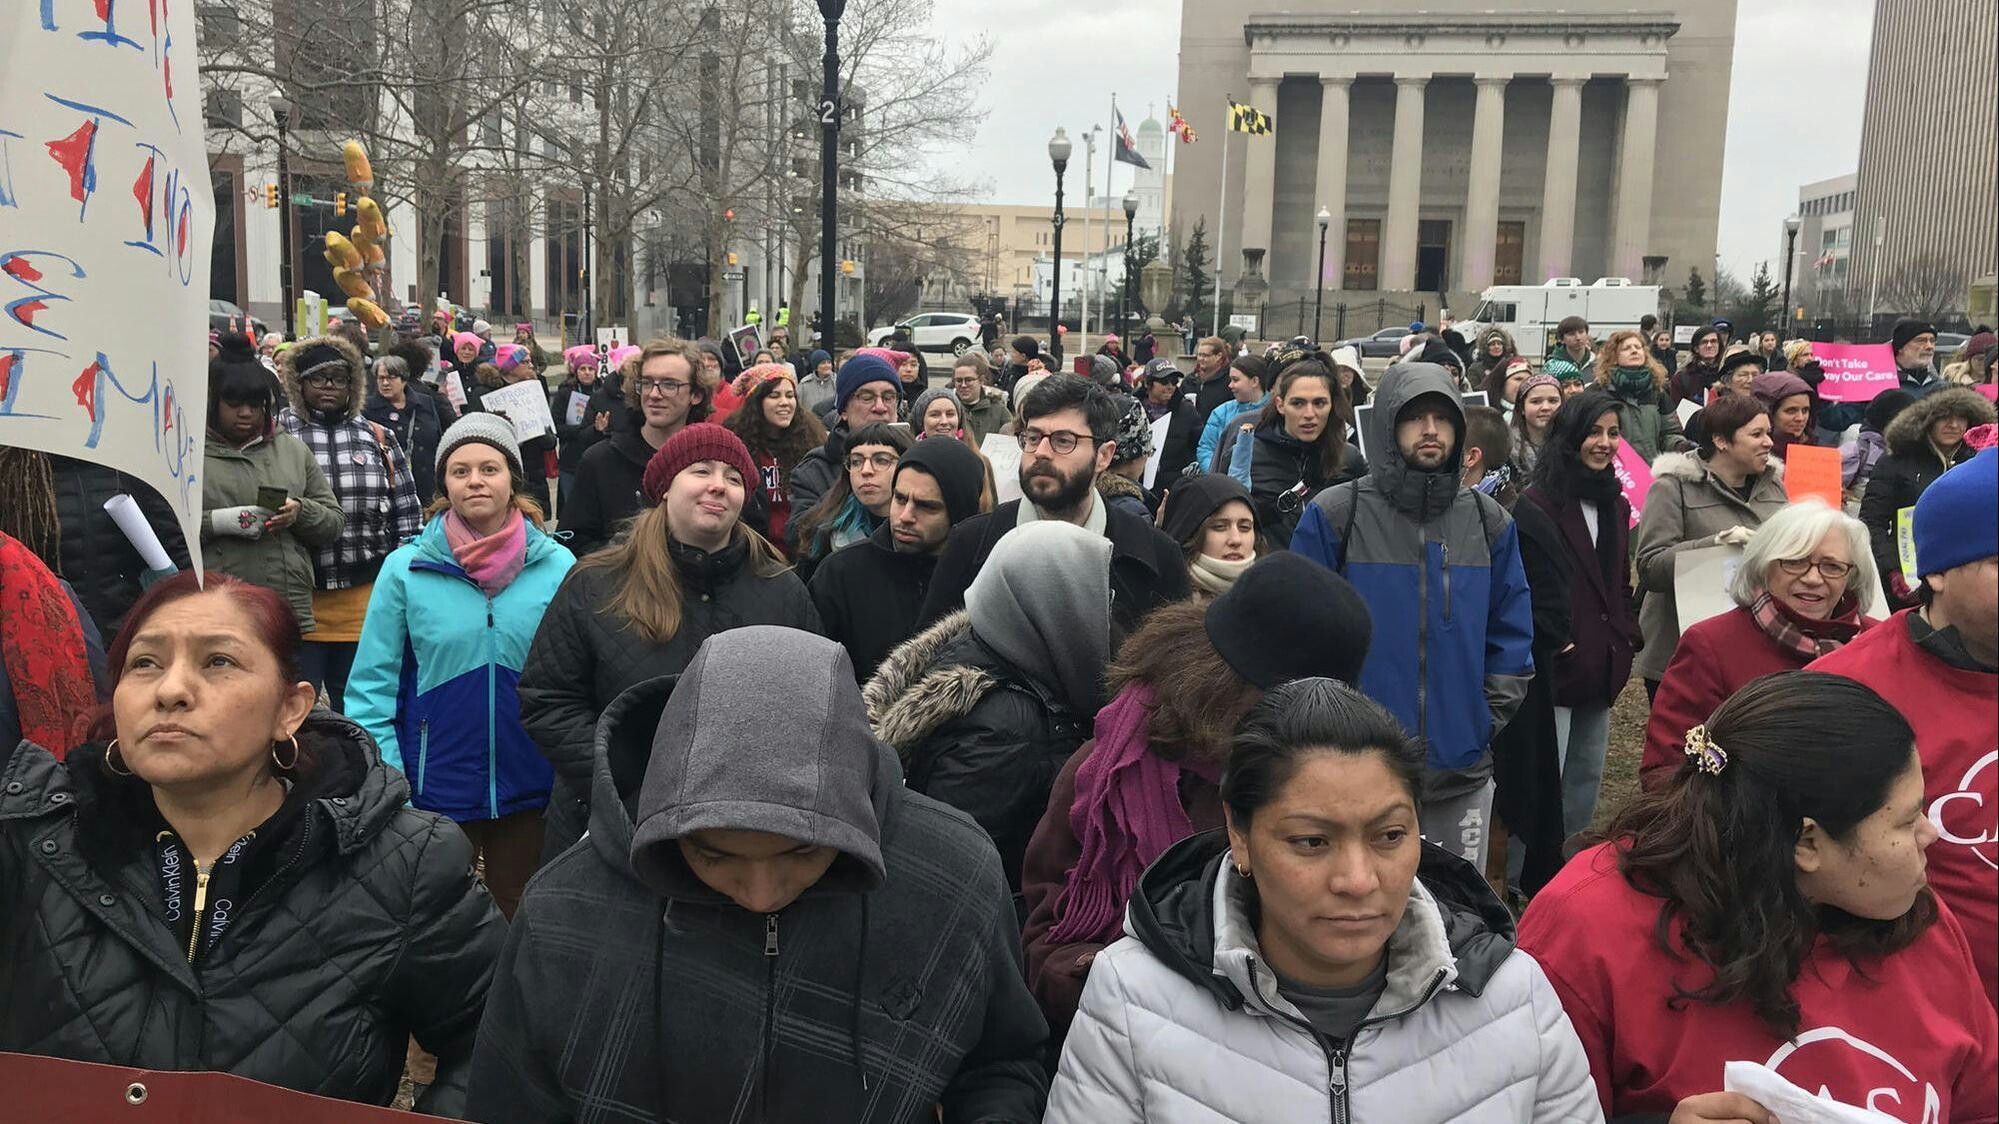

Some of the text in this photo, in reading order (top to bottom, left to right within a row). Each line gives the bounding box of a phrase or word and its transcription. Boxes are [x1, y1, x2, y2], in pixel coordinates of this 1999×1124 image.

[822, 100, 835, 123] 2
[1055, 214, 1061, 226] 3
[1814, 355, 1869, 369] Don't Take
[1824, 372, 1841, 383] way
[1842, 371, 1863, 381] Our
[1928, 792, 1998, 844] C
[161, 844, 180, 878] Klein
[208, 899, 232, 948] Calvi
